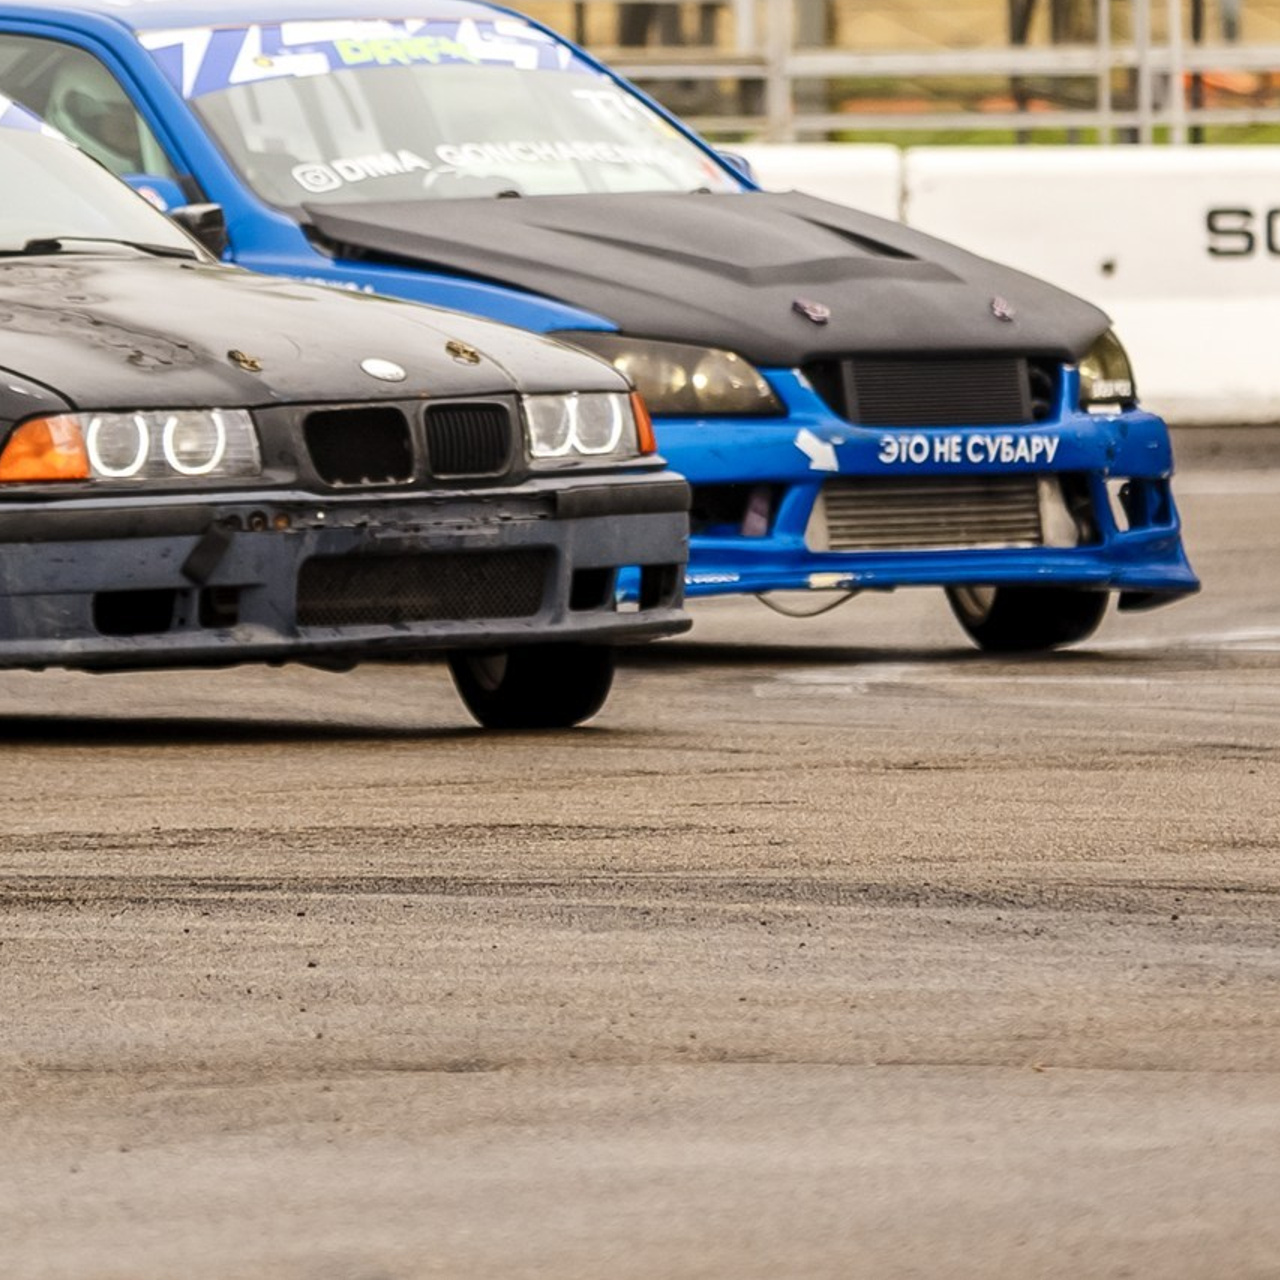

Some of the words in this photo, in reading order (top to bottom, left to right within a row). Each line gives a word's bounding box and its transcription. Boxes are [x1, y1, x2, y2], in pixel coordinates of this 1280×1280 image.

[1206, 208, 1280, 256] S
[878, 434, 930, 464] ЭТО
[933, 435, 963, 463] НЕ
[966, 434, 1060, 464] СУБАРУ
